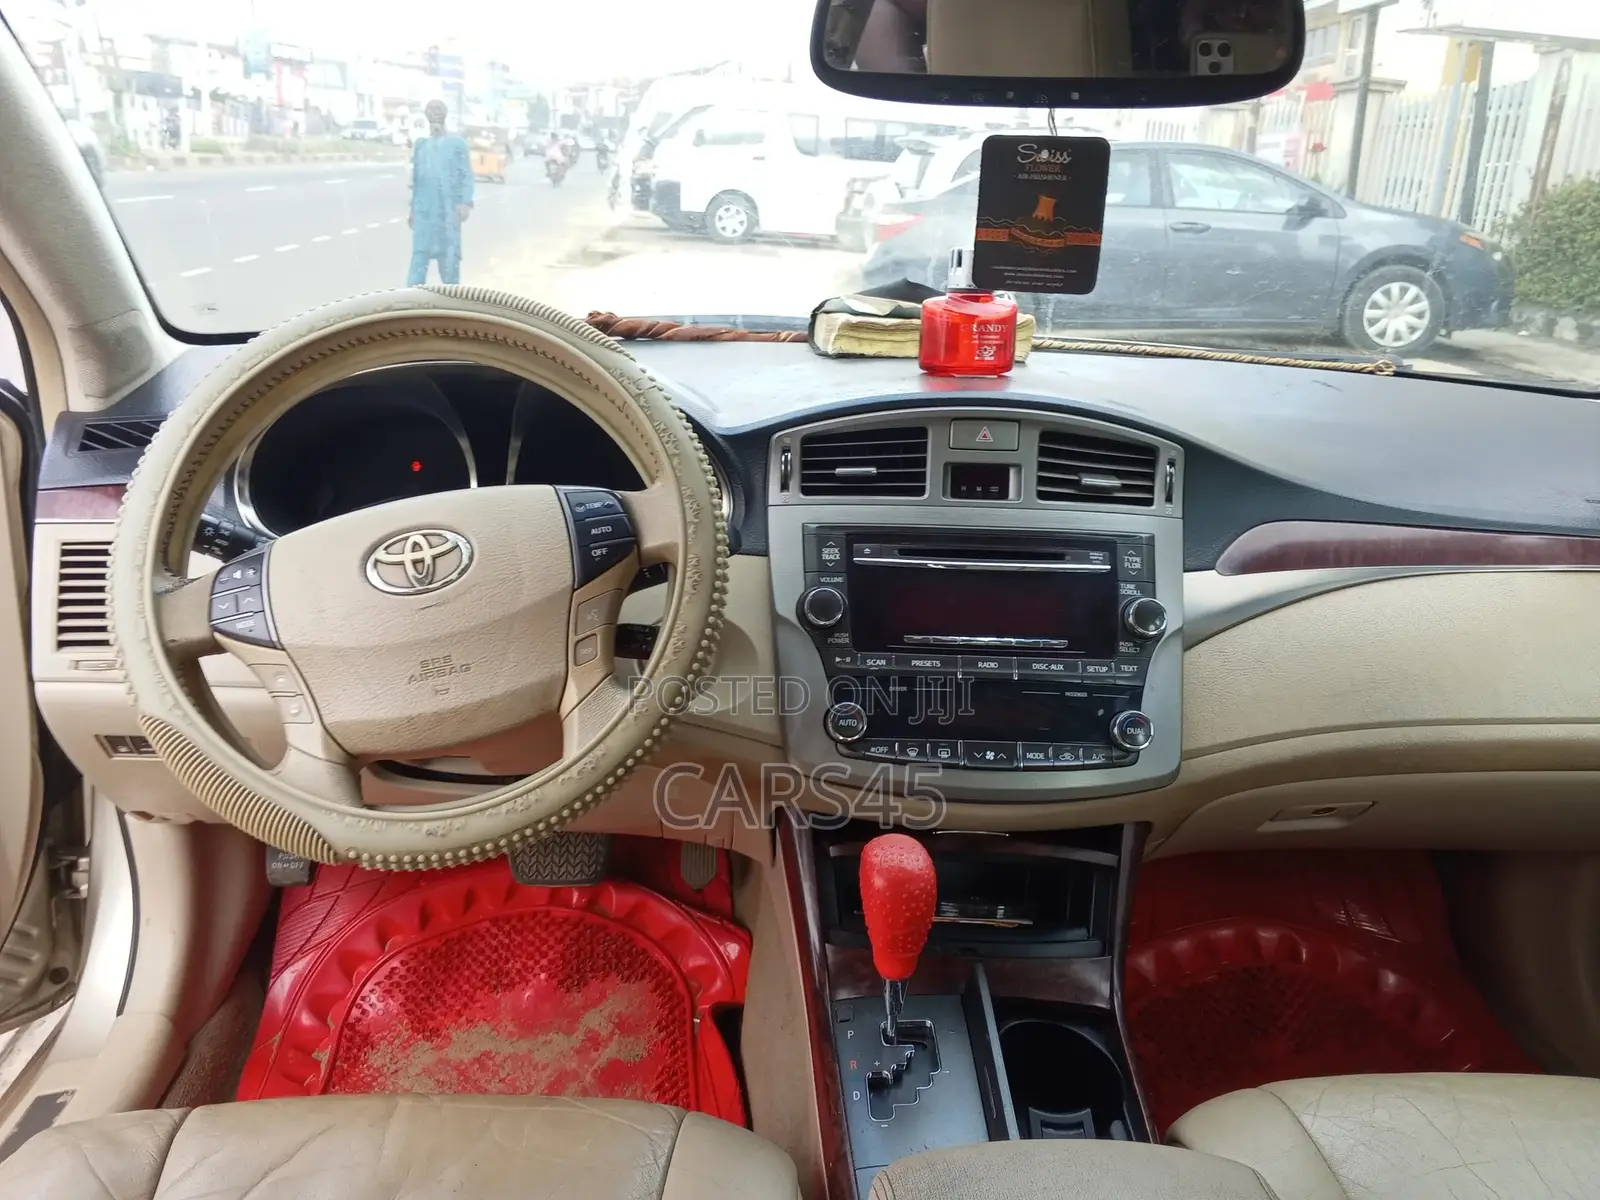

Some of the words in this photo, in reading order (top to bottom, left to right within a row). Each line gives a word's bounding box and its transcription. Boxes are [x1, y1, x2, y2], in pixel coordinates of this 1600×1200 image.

[590, 525, 613, 535] AUTO
[591, 547, 608, 557] OFF
[1123, 555, 1142, 563] TYPE
[1086, 665, 1109, 673] SETUP
[1119, 664, 1139, 672] TEXT
[407, 662, 472, 685] AIRBAG
[838, 718, 858, 727] AUTO
[1126, 727, 1146, 735] DUAL
[875, 746, 889, 754] OFF
[1026, 752, 1045, 760] MODE
[1091, 752, 1106, 761] A/C
[847, 1030, 855, 1040] P
[850, 1060, 857, 1069] R
[853, 1091, 861, 1101] D
